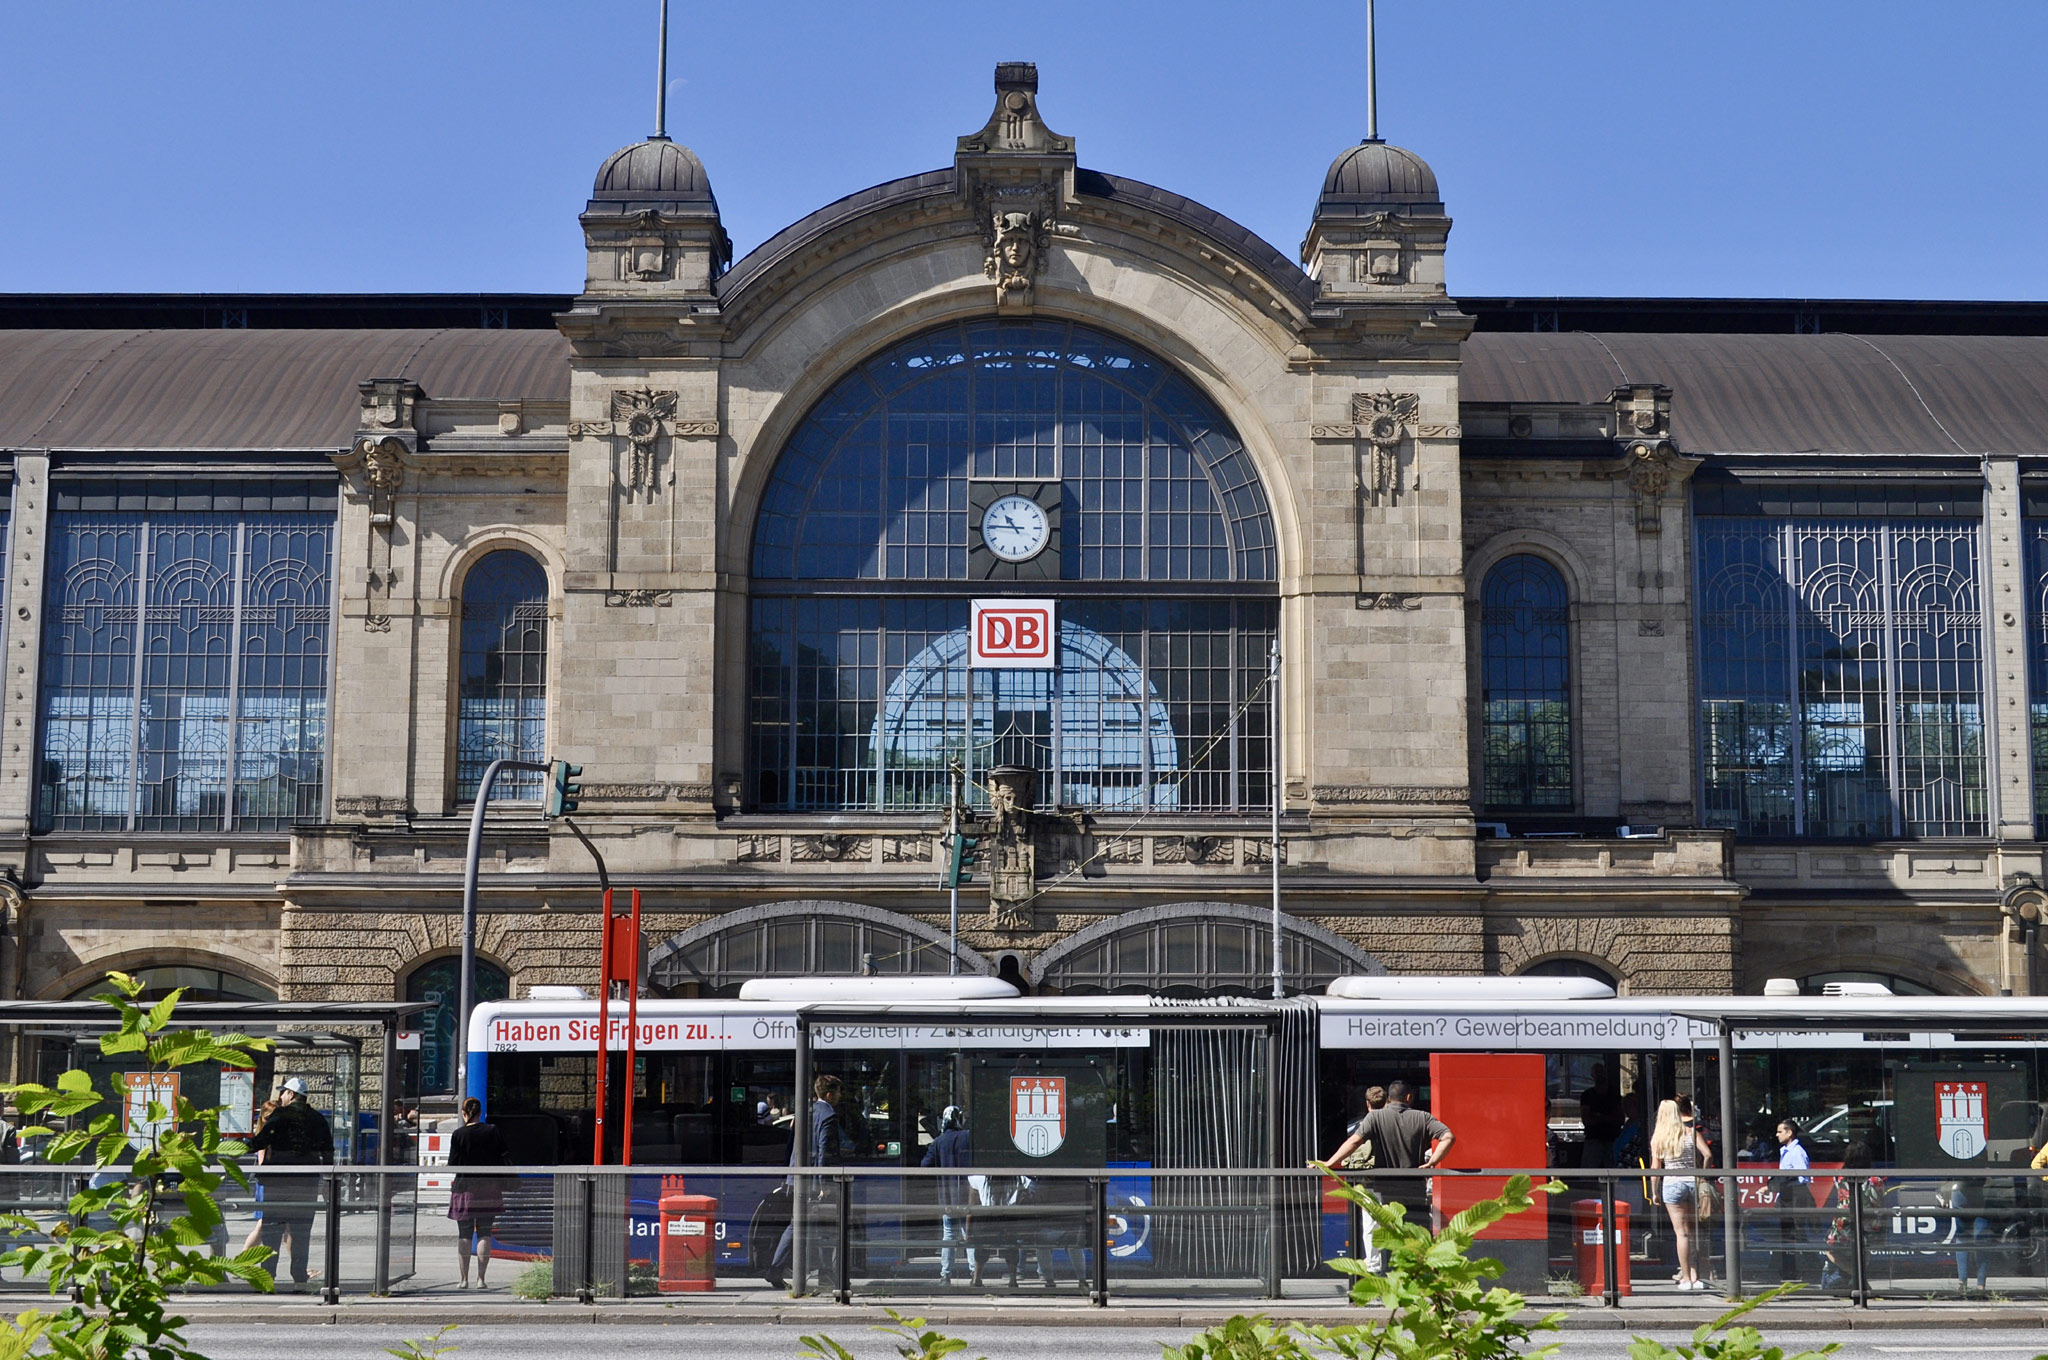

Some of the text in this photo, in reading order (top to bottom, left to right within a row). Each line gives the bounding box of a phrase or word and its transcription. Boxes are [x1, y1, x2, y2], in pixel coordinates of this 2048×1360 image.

[986, 616, 1040, 649] DB
[496, 1020, 560, 1041] Haben
[568, 1020, 600, 1041] Sie
[686, 1023, 732, 1041] zu...
[1348, 1017, 1447, 1037] Heiraten?
[1455, 1017, 1678, 1041] Gewerbeanmeldung?
[494, 1043, 518, 1052] 7822
